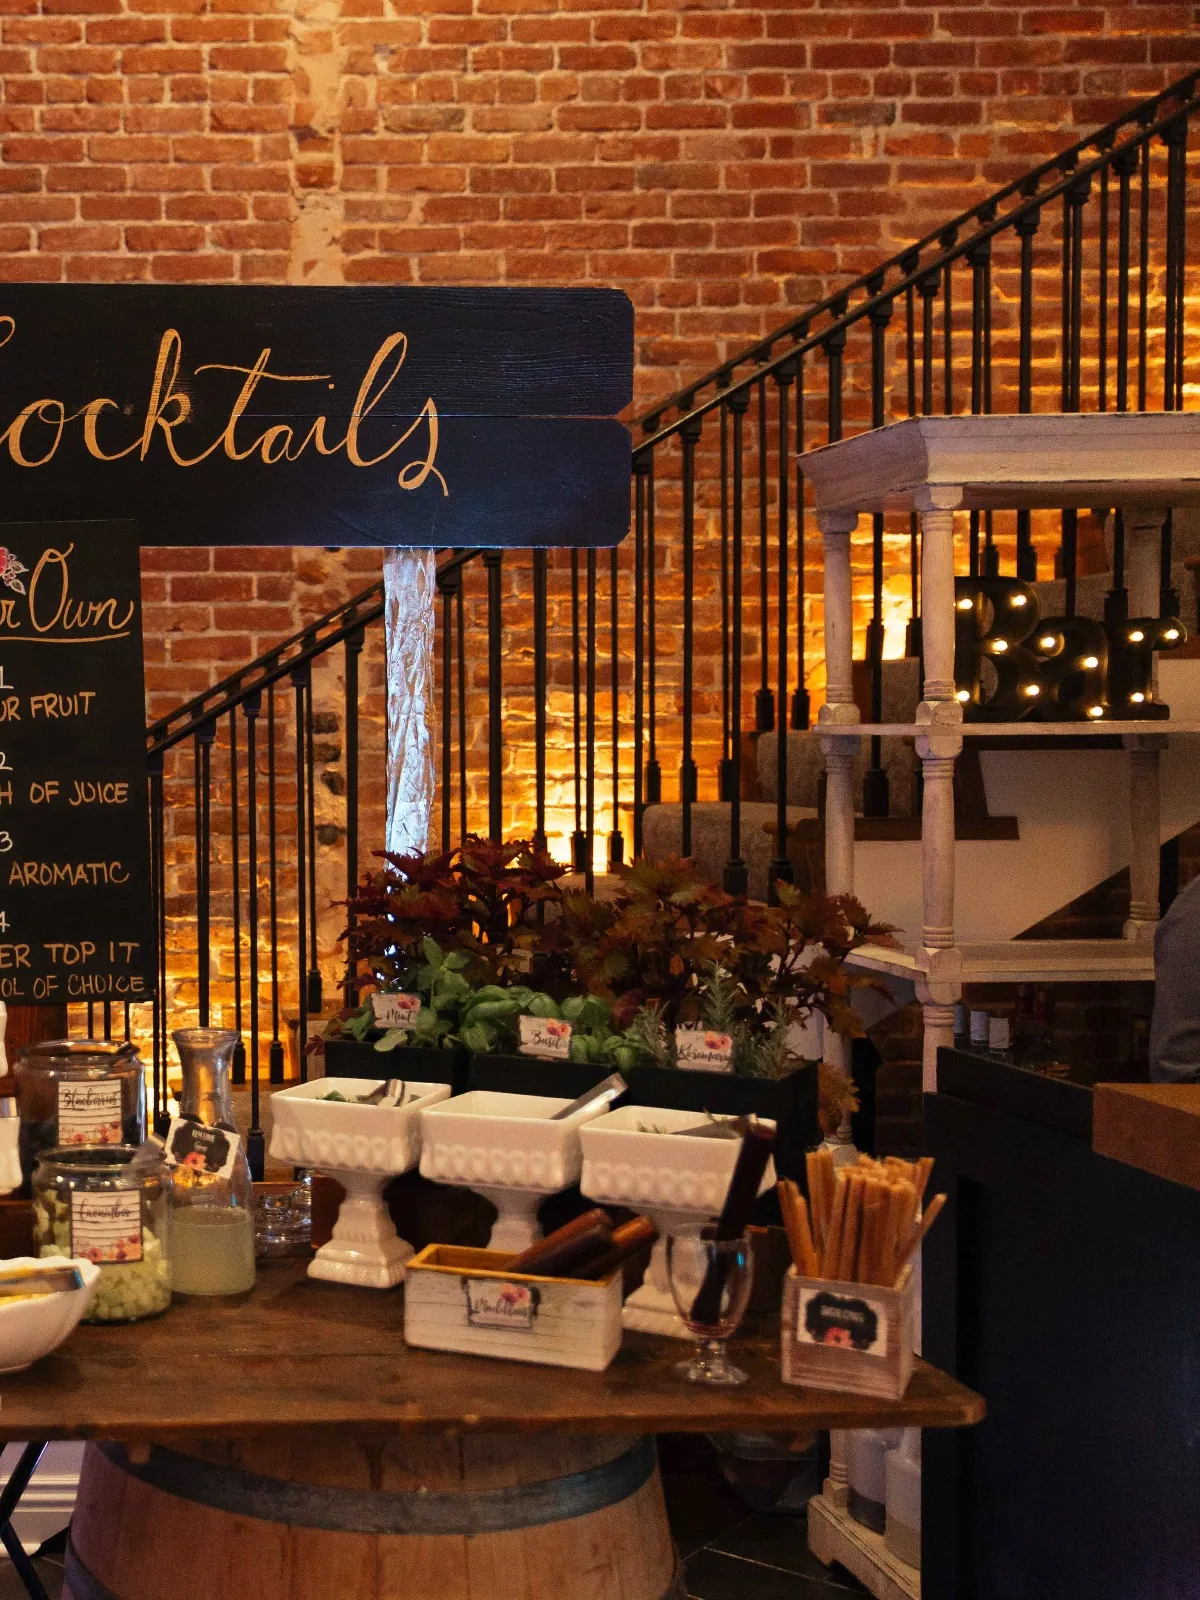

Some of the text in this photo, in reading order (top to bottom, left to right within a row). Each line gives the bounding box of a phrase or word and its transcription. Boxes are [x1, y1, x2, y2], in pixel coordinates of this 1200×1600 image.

[29, 543, 134, 633] Own
[953, 576, 1187, 721] Bar
[31, 691, 96, 718] FRUIT
[29, 780, 60, 805] OF
[69, 780, 129, 806] JUICE
[9, 861, 130, 887] AROMATIC
[43, 941, 96, 966] TOP
[108, 941, 140, 965] IT
[33, 975, 59, 998] OF
[67, 973, 145, 996] CHOICE
[386, 1008, 414, 1023] Mint
[531, 1029, 561, 1049] Basil
[61, 1087, 118, 1108] Blueberries
[79, 1196, 132, 1221] Cucumber
